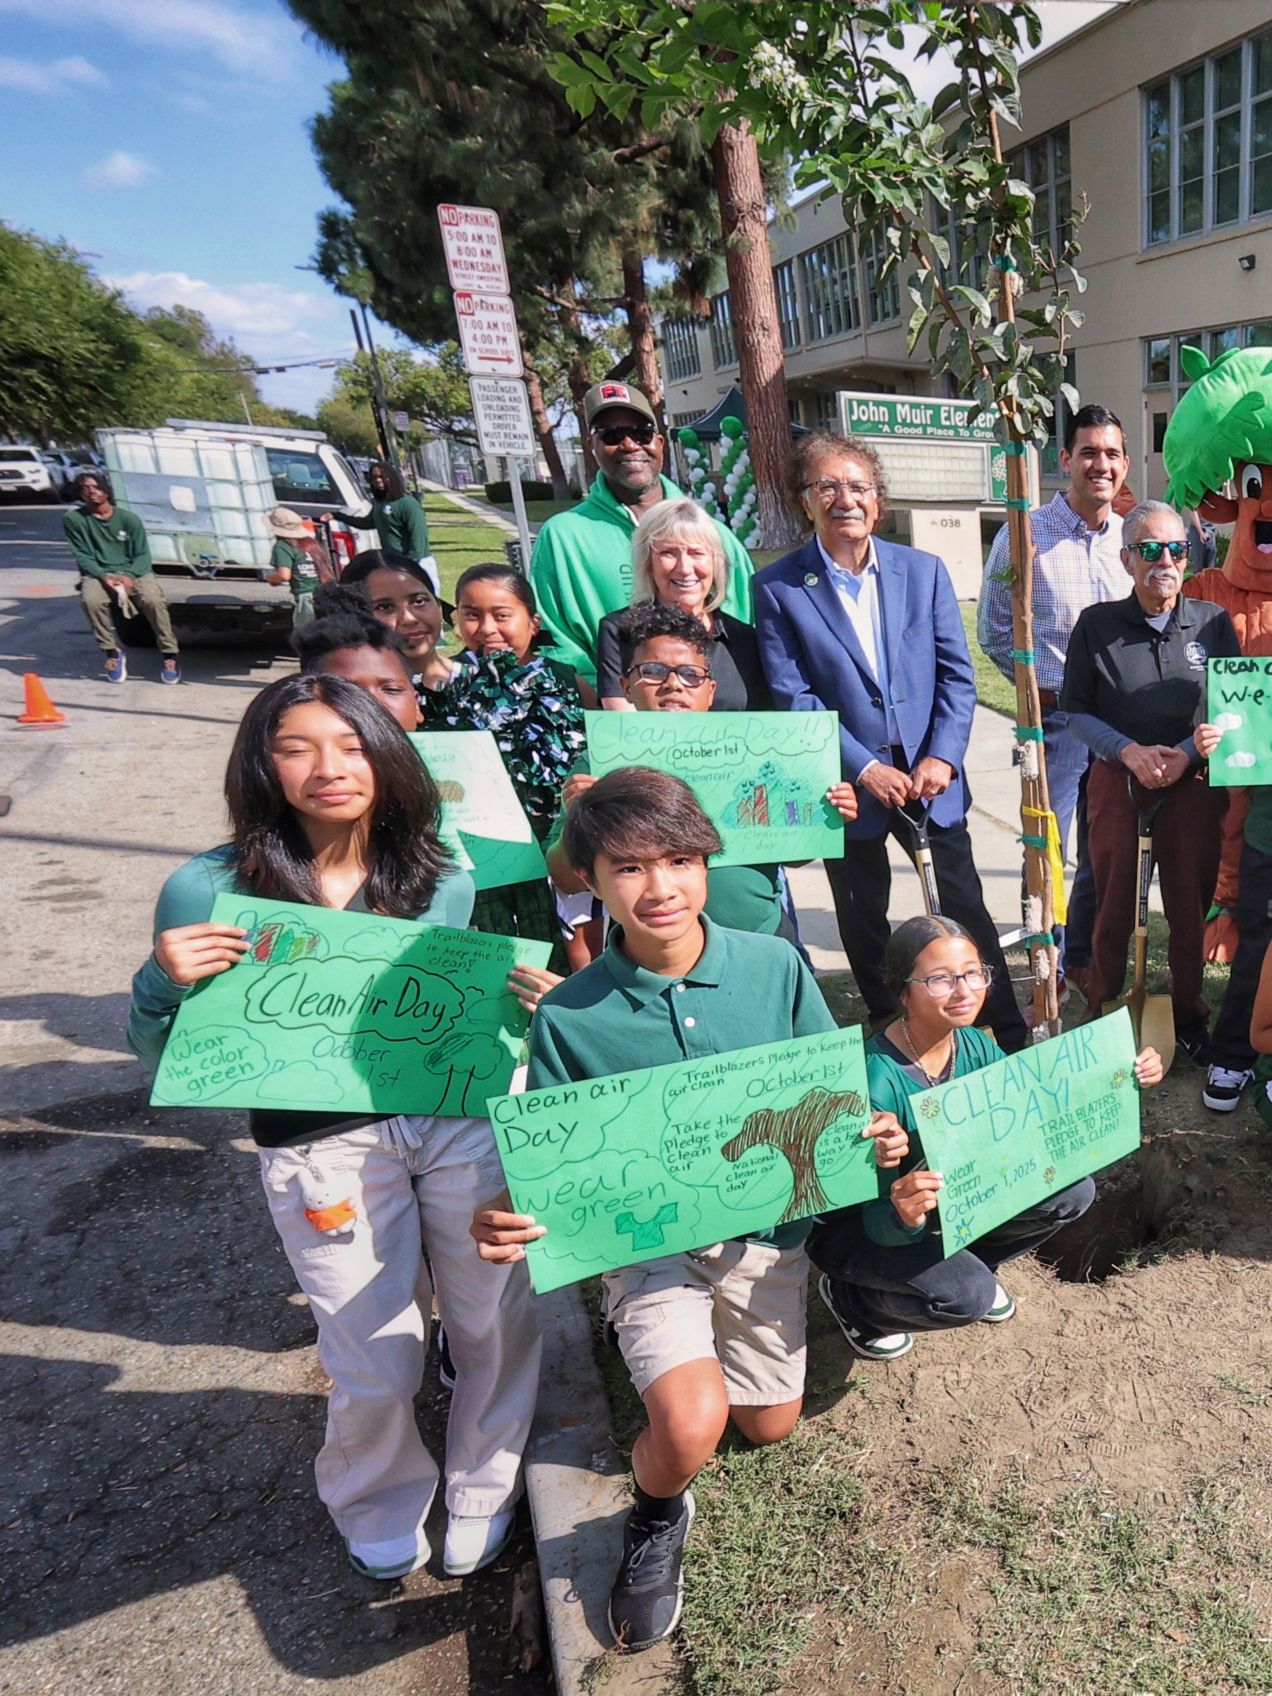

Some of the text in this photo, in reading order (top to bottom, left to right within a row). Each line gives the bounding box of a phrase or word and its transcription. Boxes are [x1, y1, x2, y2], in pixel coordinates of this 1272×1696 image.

[441, 206, 495, 228] NO PARKING
[472, 233, 484, 243] AM
[487, 234, 497, 245] TO
[480, 249, 493, 259] AM
[452, 260, 502, 273] WEDNESDAY
[457, 297, 511, 314] NO PARKING
[487, 321, 499, 331] AM
[501, 322, 512, 333] TO
[496, 335, 508, 345] PM
[478, 384, 518, 394] PASSENGER
[477, 394, 522, 404] LOADING AND
[482, 403, 520, 412] UNLOADING
[851, 401, 889, 422] John
[896, 403, 933, 424] Muir
[492, 422, 517, 431] DRIVER
[894, 425, 923, 435] Good
[927, 426, 955, 436] Place
[958, 428, 970, 437] To
[484, 431, 529, 440] MUST REMAIN
[940, 518, 961, 528] 038
[591, 715, 677, 748] Clean
[683, 721, 733, 747] air
[672, 743, 739, 760] October 1st
[426, 944, 438, 952] to
[445, 946, 469, 958] keep
[474, 949, 490, 960] the
[260, 972, 446, 1033] Clean Air Day
[171, 1035, 229, 1062] Wear
[312, 1035, 391, 1063] October
[165, 1045, 250, 1081] the color
[682, 1057, 765, 1084] Trailblazers
[807, 1045, 817, 1056] to
[849, 1036, 864, 1046] the
[187, 1062, 255, 1099] green
[366, 1063, 401, 1088] 1st
[746, 1061, 846, 1098] October 1st
[942, 1025, 1099, 1126] CLEAN AIR
[493, 1077, 632, 1124] Clean air
[668, 1086, 688, 1098] air
[989, 1077, 1070, 1142] DAY!
[672, 1114, 741, 1136] Take the
[1045, 1103, 1121, 1150] PLEDGE TO KEEP
[504, 1120, 579, 1154] Day
[715, 1128, 729, 1141] to
[819, 1136, 830, 1147] is
[833, 1136, 841, 1144] a
[817, 1142, 845, 1158] way
[1049, 1145, 1067, 1163] THE
[1070, 1136, 1086, 1154] AIR
[669, 1159, 697, 1174] air
[760, 1163, 777, 1174] air
[820, 1158, 834, 1170] go
[943, 1160, 977, 1186] Wear
[726, 1179, 749, 1193] day
[947, 1174, 981, 1200] Green
[565, 1182, 667, 1237] green
[946, 1184, 998, 1222] October
